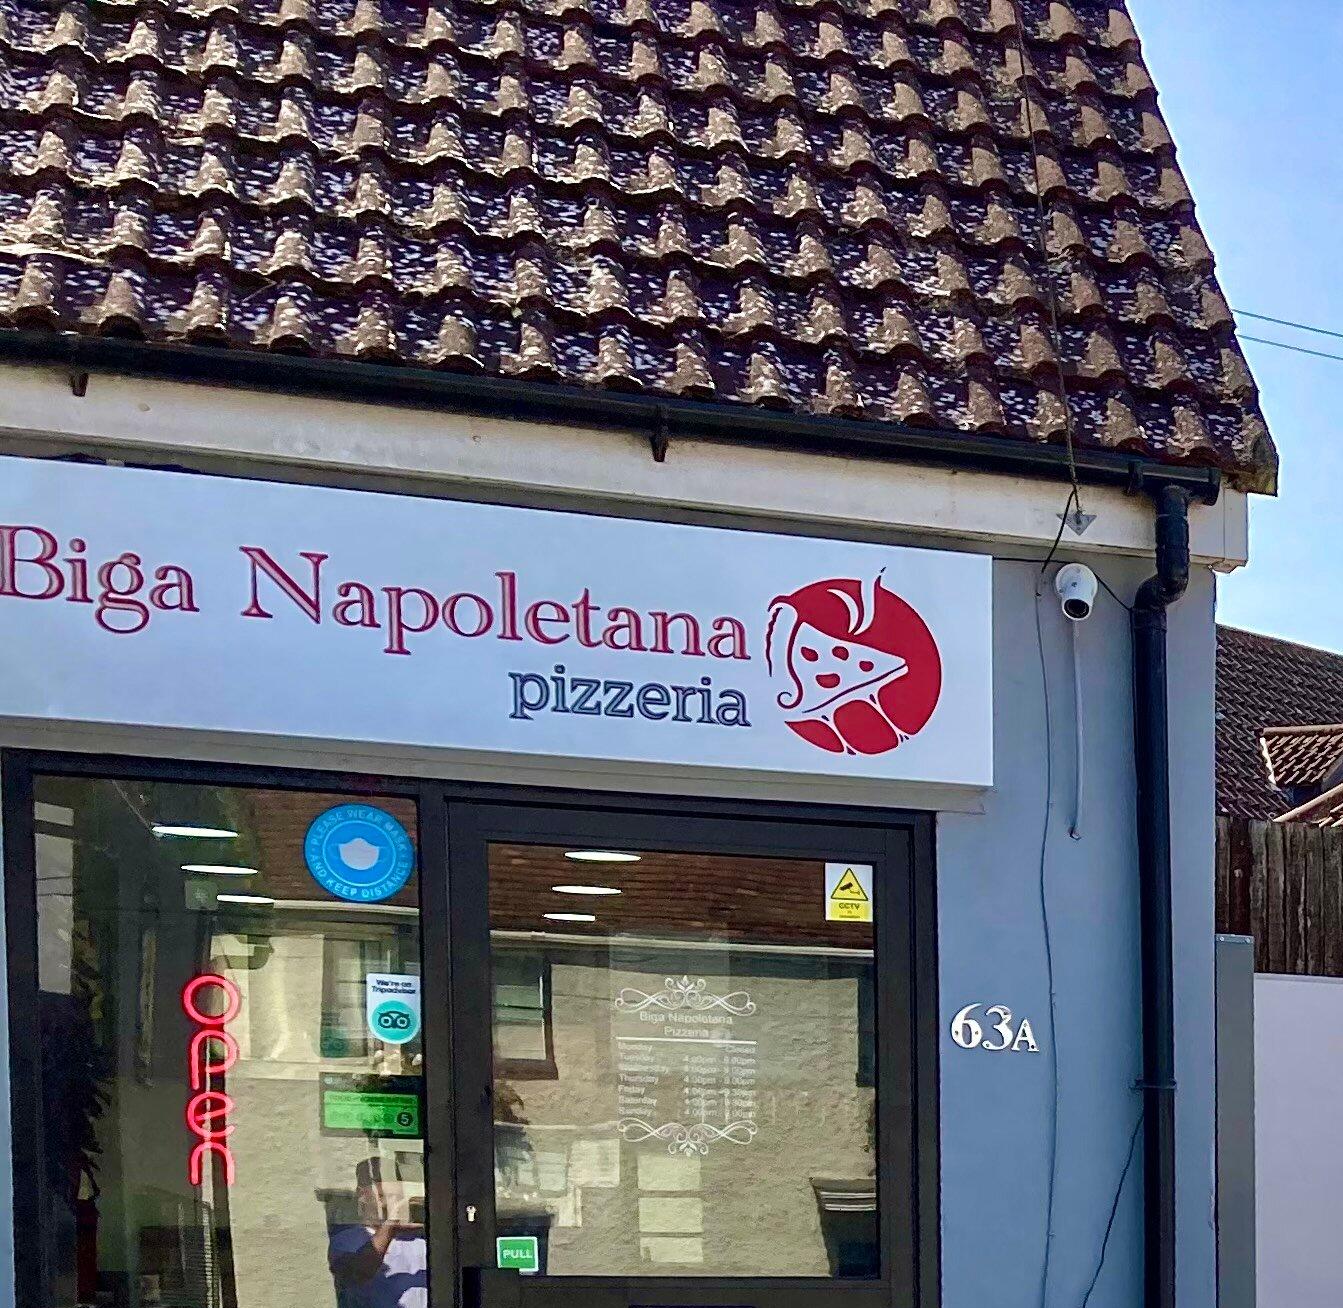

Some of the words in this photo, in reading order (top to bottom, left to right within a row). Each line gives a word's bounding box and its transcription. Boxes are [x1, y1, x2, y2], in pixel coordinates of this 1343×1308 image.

[0, 525, 200, 634] Biga
[238, 546, 752, 660] Napoletana
[507, 664, 752, 727] pizzeria
[310, 811, 343, 847] PLEASE
[346, 809, 384, 825] WEAR
[327, 879, 358, 897] KEEP
[361, 861, 409, 898] DISTANCE
[950, 1002, 1040, 1052] 63A
[400, 1113, 410, 1125] 5
[502, 1248, 533, 1259] PULL
